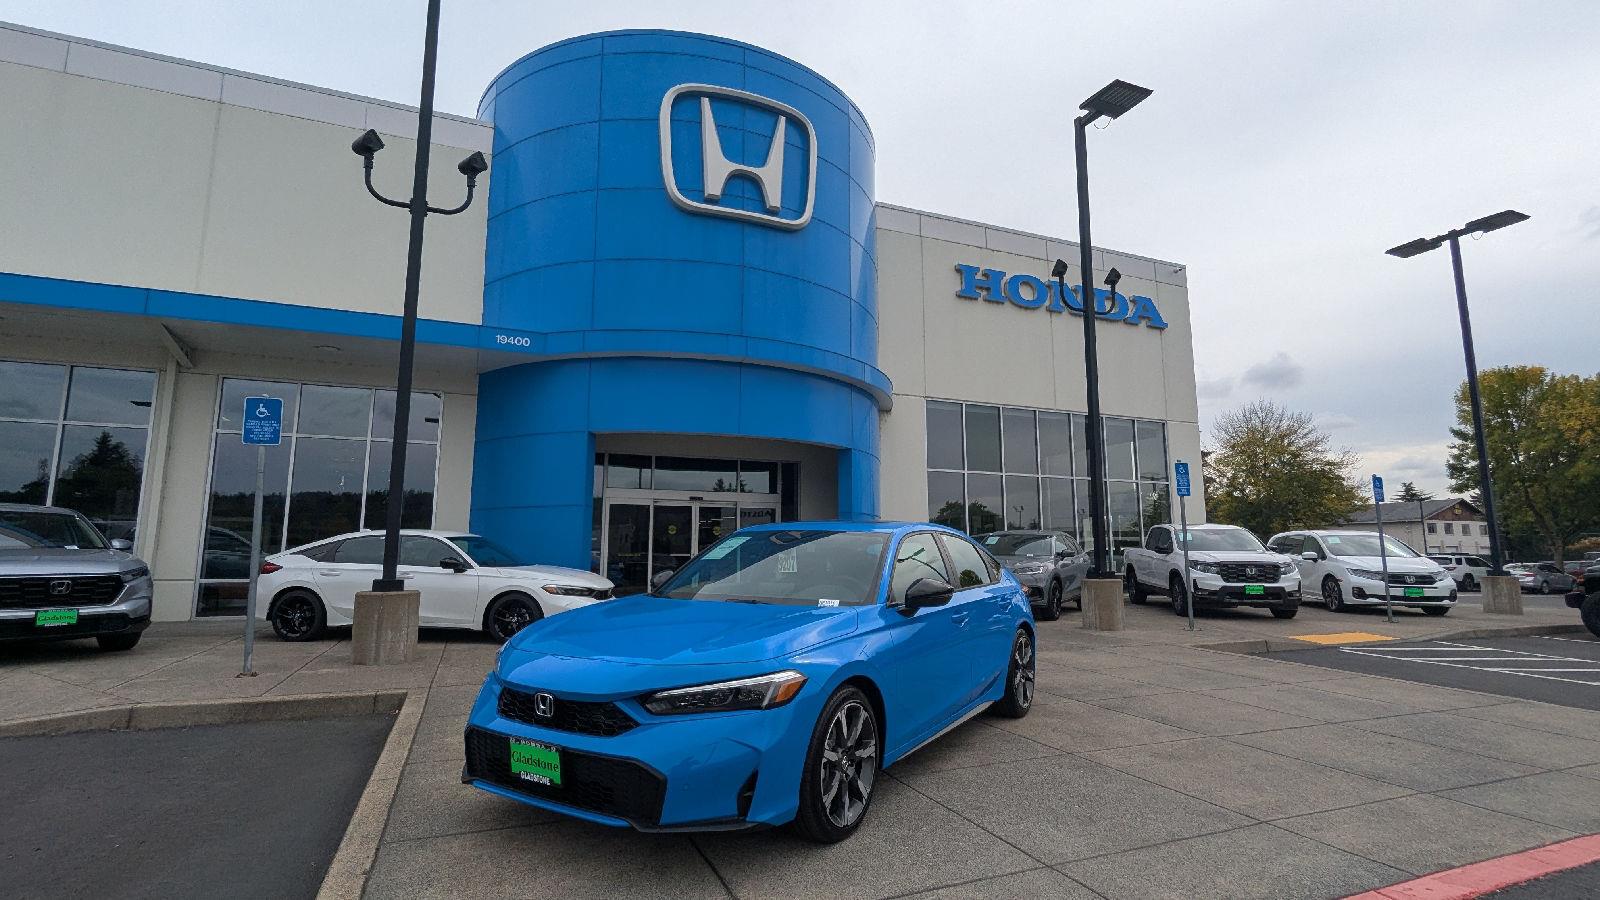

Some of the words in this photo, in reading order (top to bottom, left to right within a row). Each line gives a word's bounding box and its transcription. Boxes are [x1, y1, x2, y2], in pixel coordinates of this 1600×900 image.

[955, 263, 1168, 329] HONDA
[496, 334, 531, 347] 19400
[511, 750, 560, 773] Gladstone
[520, 770, 551, 786] GLADSTONE
